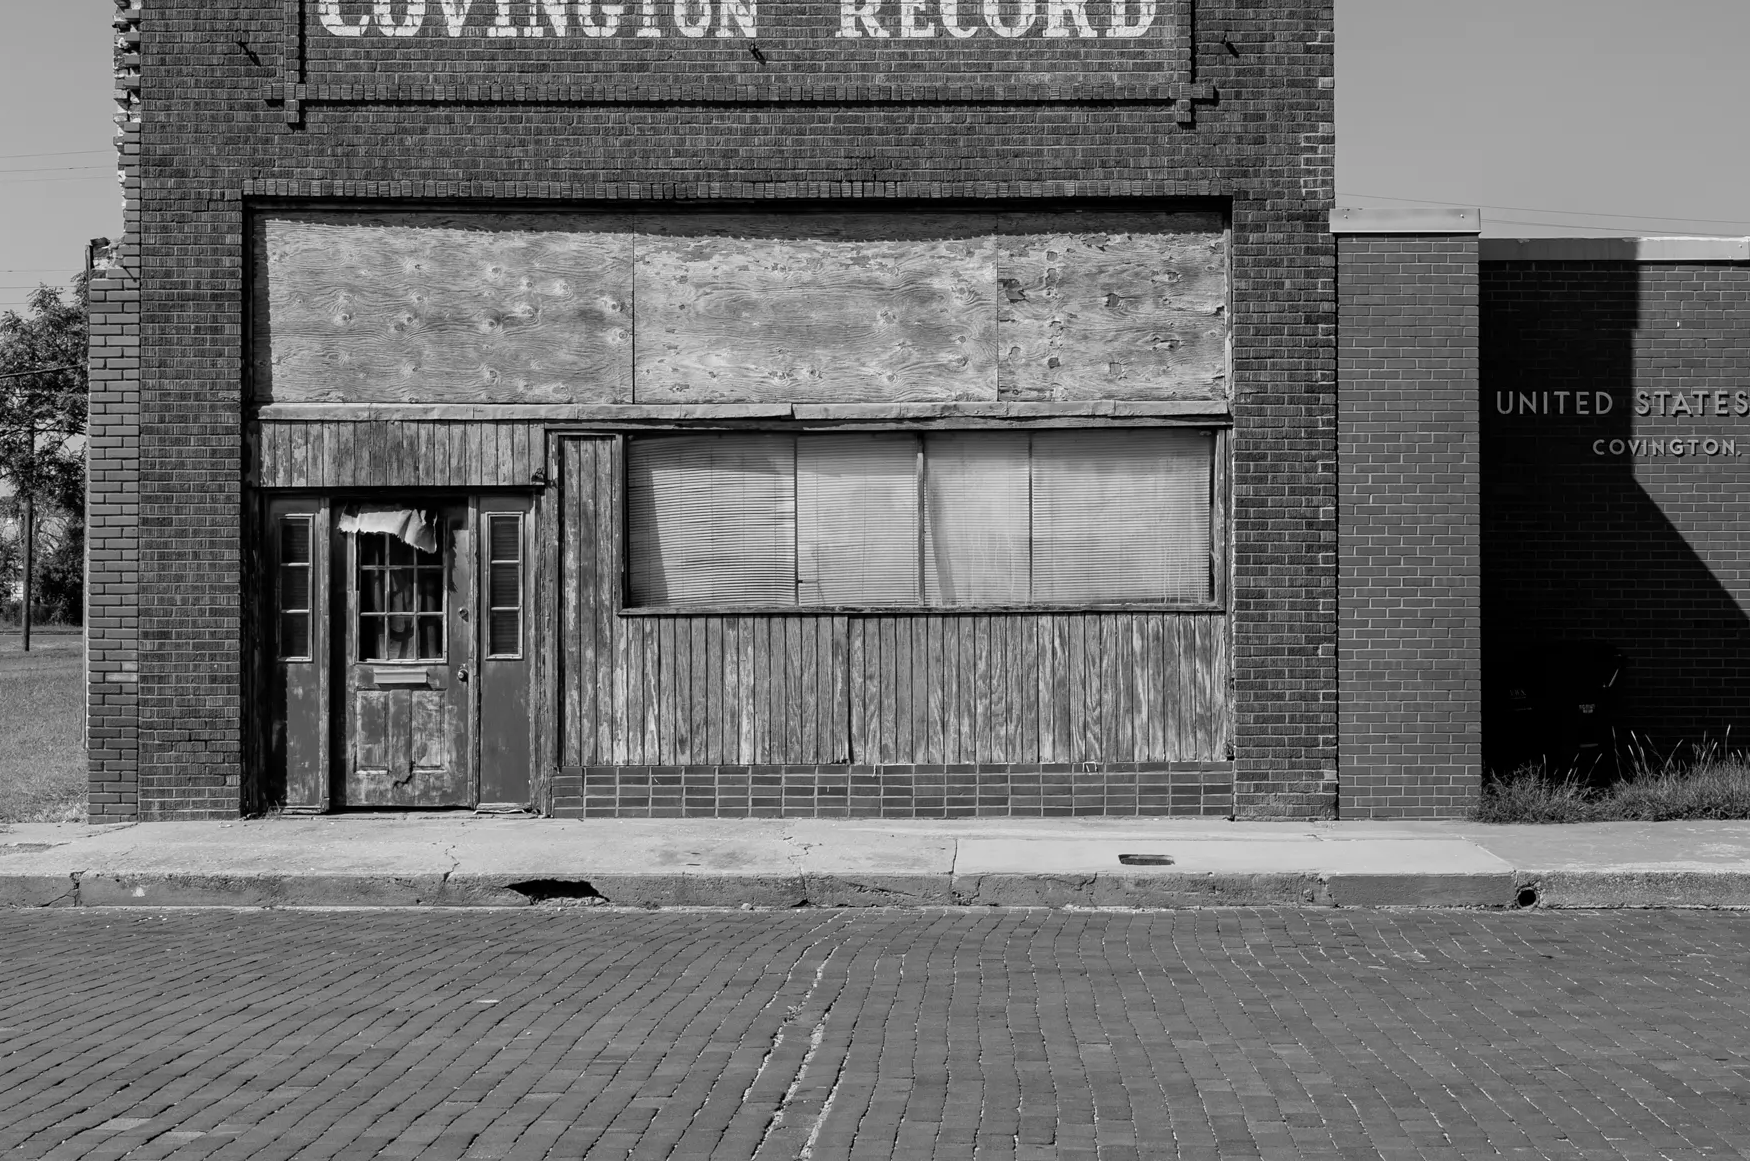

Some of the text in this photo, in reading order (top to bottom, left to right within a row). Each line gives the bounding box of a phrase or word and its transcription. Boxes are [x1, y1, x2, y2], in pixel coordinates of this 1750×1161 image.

[1496, 390, 1750, 415] UNITED STATES
[1592, 438, 1742, 456] COVINGTON,
